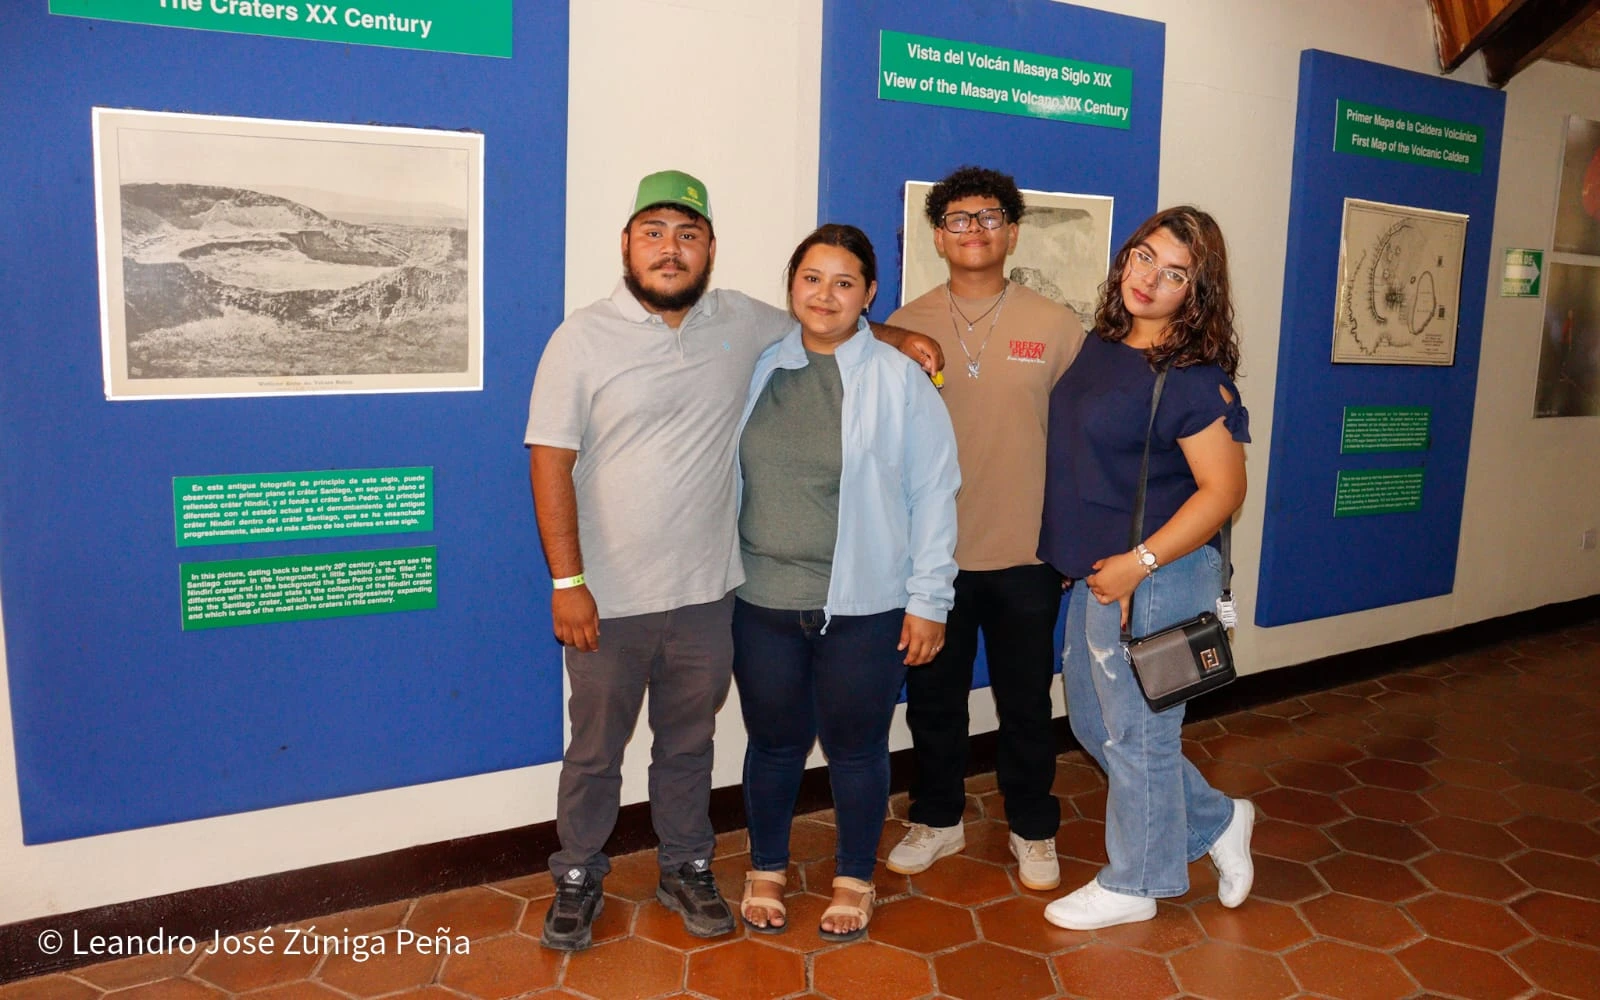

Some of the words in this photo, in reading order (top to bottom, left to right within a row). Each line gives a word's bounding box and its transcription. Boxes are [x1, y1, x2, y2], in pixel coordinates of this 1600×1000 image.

[210, 0, 297, 20] Craters
[306, 3, 336, 24] XX
[344, 8, 432, 37] Century
[907, 43, 940, 61] Vista
[943, 49, 963, 64] del
[967, 52, 1010, 71] Volcán
[1013, 59, 1058, 80] Masaya
[1061, 66, 1090, 85] Siglo
[1093, 72, 1111, 86] XIX
[883, 71, 916, 88] View
[919, 77, 933, 91] of
[936, 78, 957, 94] the
[960, 81, 1008, 102] Masaya
[1012, 88, 1060, 108] Volcano
[1062, 96, 1081, 112] XIX
[1083, 99, 1128, 120] Century
[1346, 108, 1372, 123] Primer
[1373, 114, 1394, 129] Mapa
[1395, 119, 1405, 129] de
[1406, 120, 1413, 131] la
[1414, 121, 1442, 136] Caldera
[1351, 133, 1369, 147] First
[1370, 137, 1387, 152] Map
[1388, 141, 1396, 151] of
[1397, 142, 1409, 153] the
[1411, 144, 1441, 158] Volcanic
[1442, 149, 1469, 163] Caldera
[1010, 340, 1046, 352] FREEZY
[1012, 349, 1042, 359] PEAZY
[186, 581, 220, 589] Santiago
[348, 567, 372, 576] behind
[278, 580, 321, 589] background
[347, 589, 393, 599] progressively
[396, 586, 432, 594] expanding
